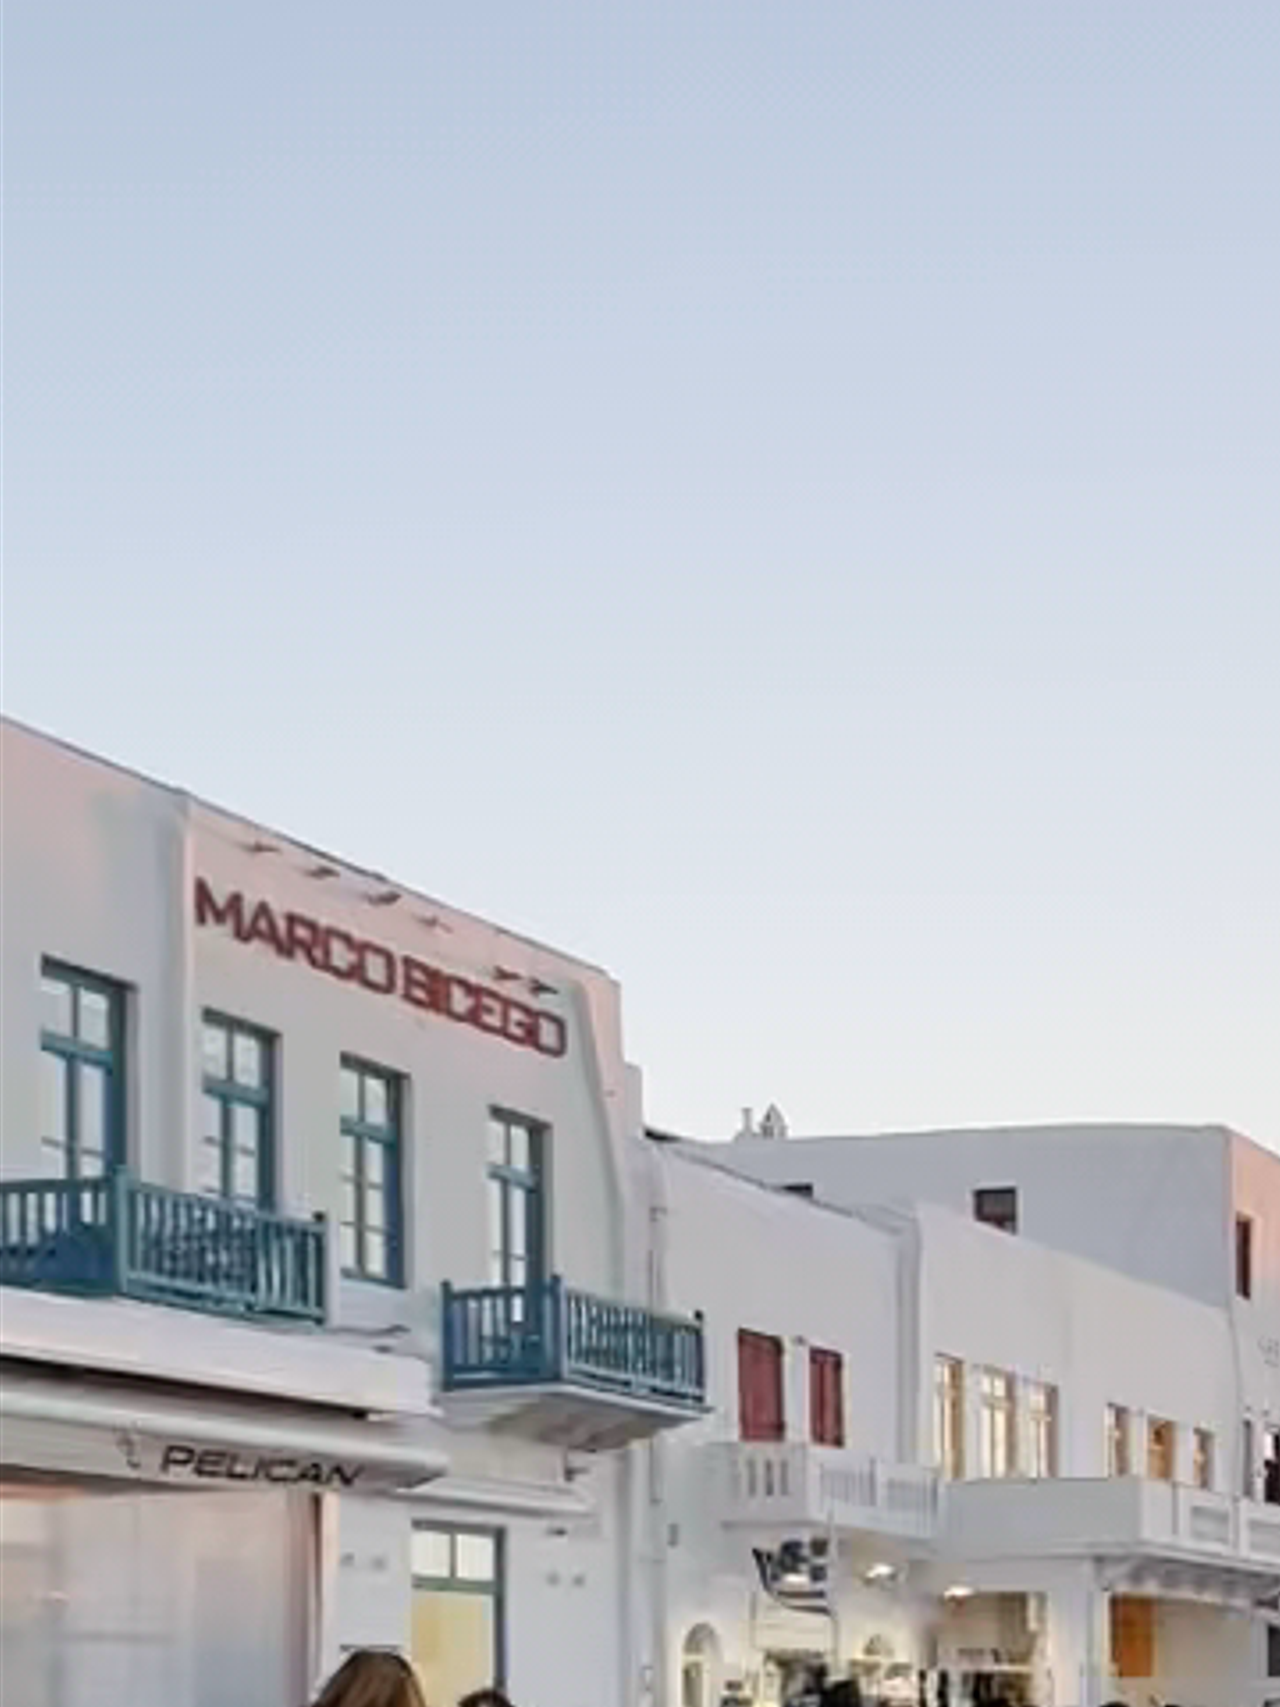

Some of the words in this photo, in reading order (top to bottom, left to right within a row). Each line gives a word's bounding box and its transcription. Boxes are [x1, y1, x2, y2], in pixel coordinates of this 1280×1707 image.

[194, 875, 397, 995] MARCO
[400, 953, 568, 1059] BICEGO
[160, 1444, 367, 1488] PELICAN
